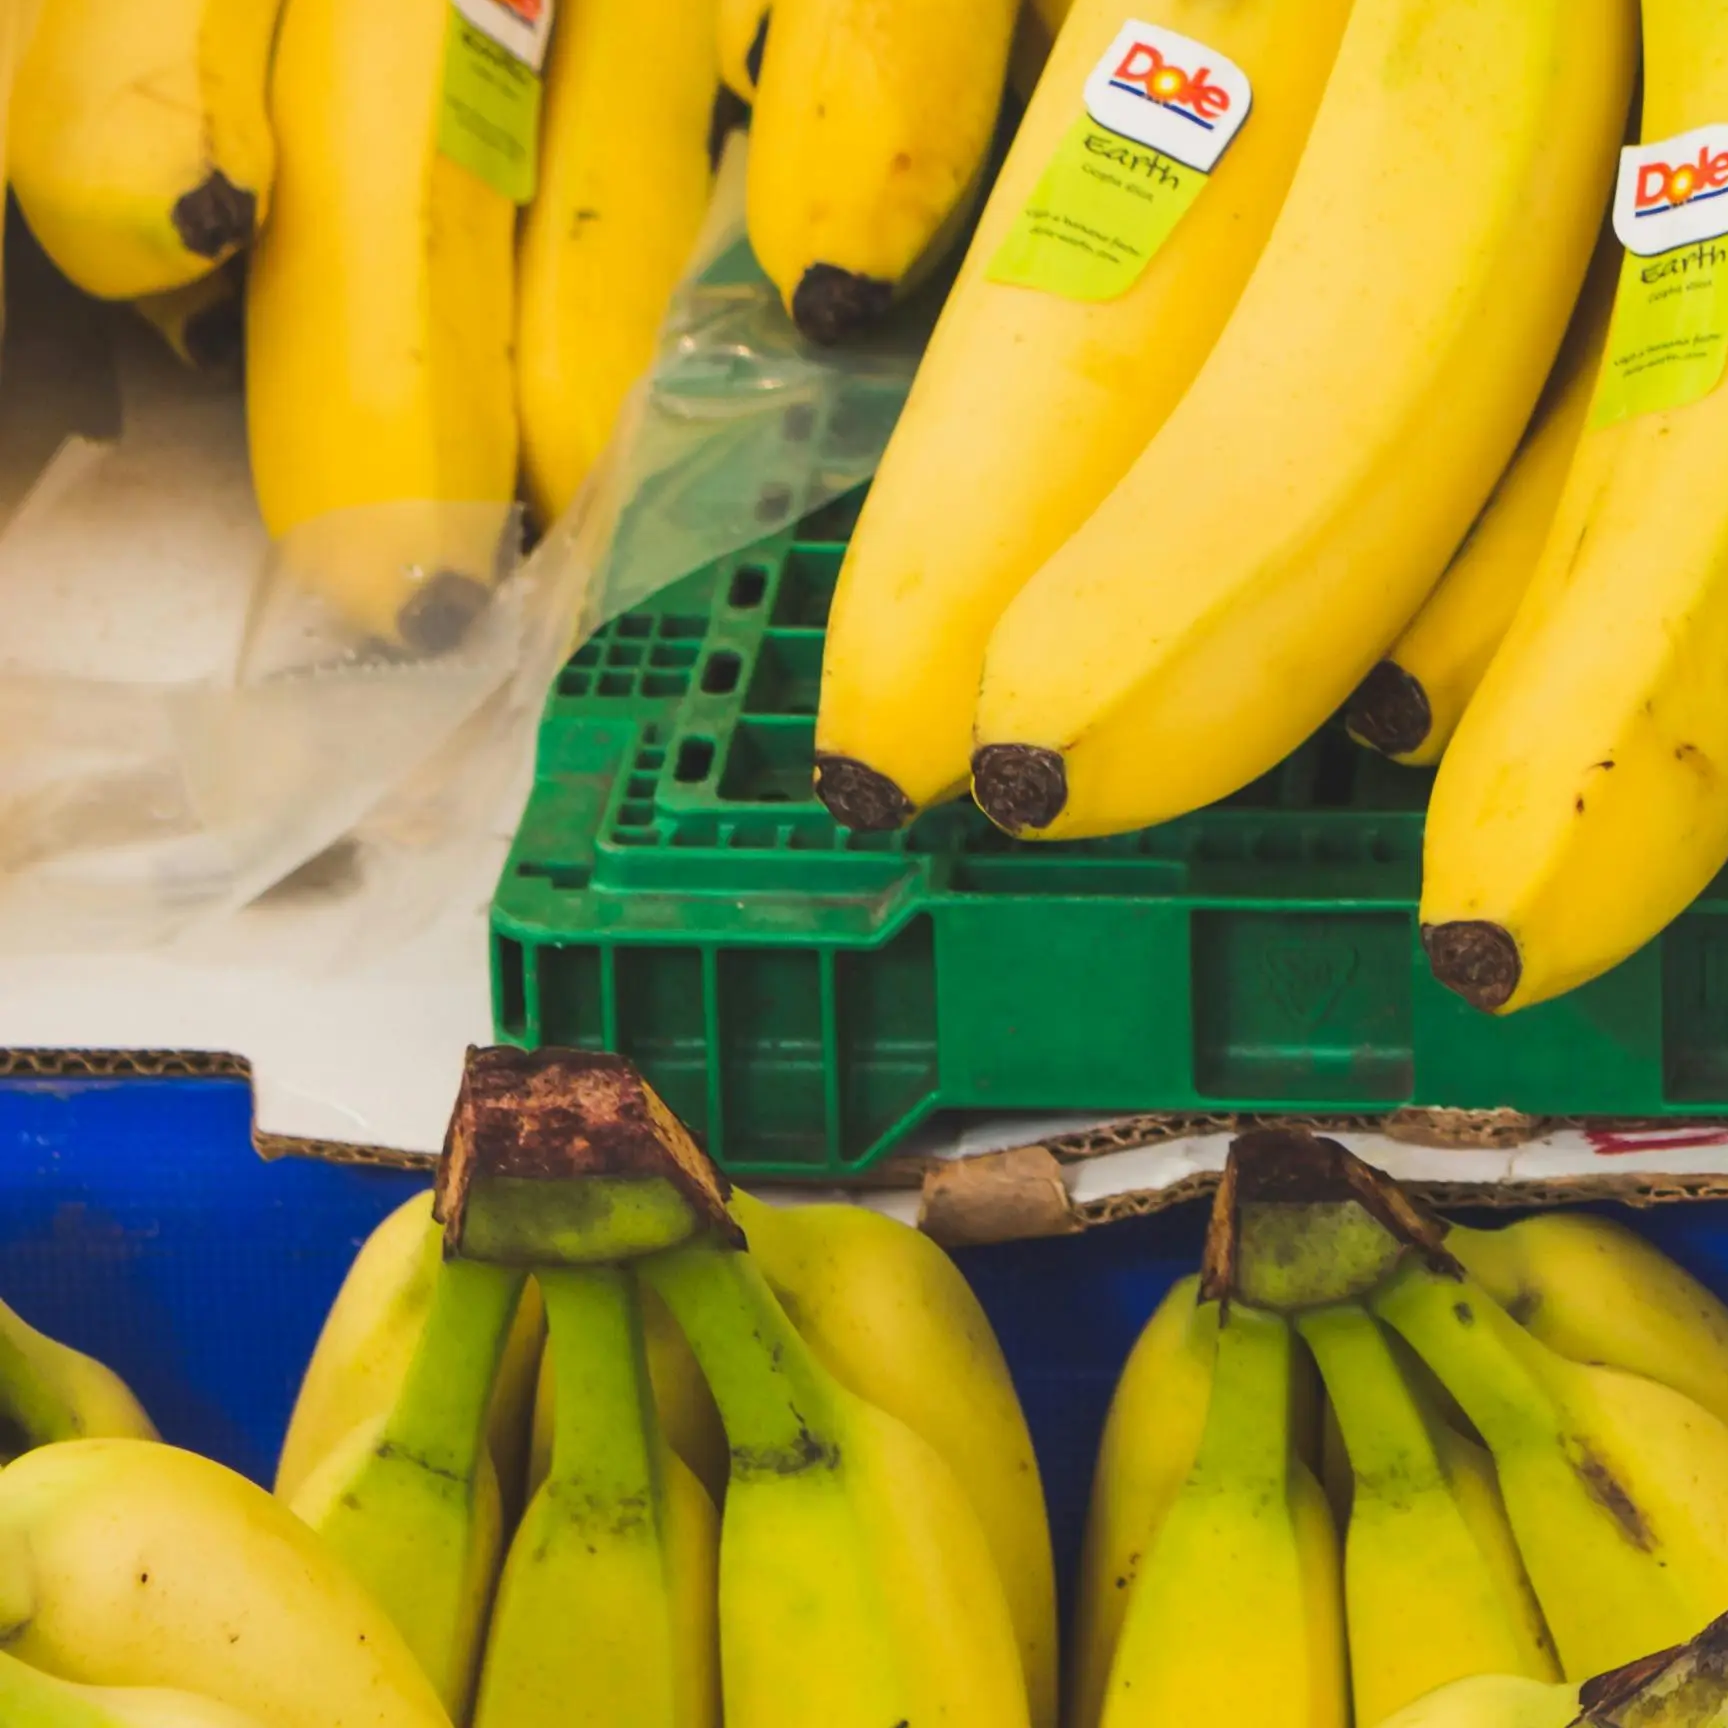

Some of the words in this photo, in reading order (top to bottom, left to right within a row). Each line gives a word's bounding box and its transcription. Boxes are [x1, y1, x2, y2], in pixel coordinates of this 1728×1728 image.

[1114, 42, 1230, 119] Dole
[1083, 133, 1180, 191] Earth
[1641, 242, 1726, 285] Earth
